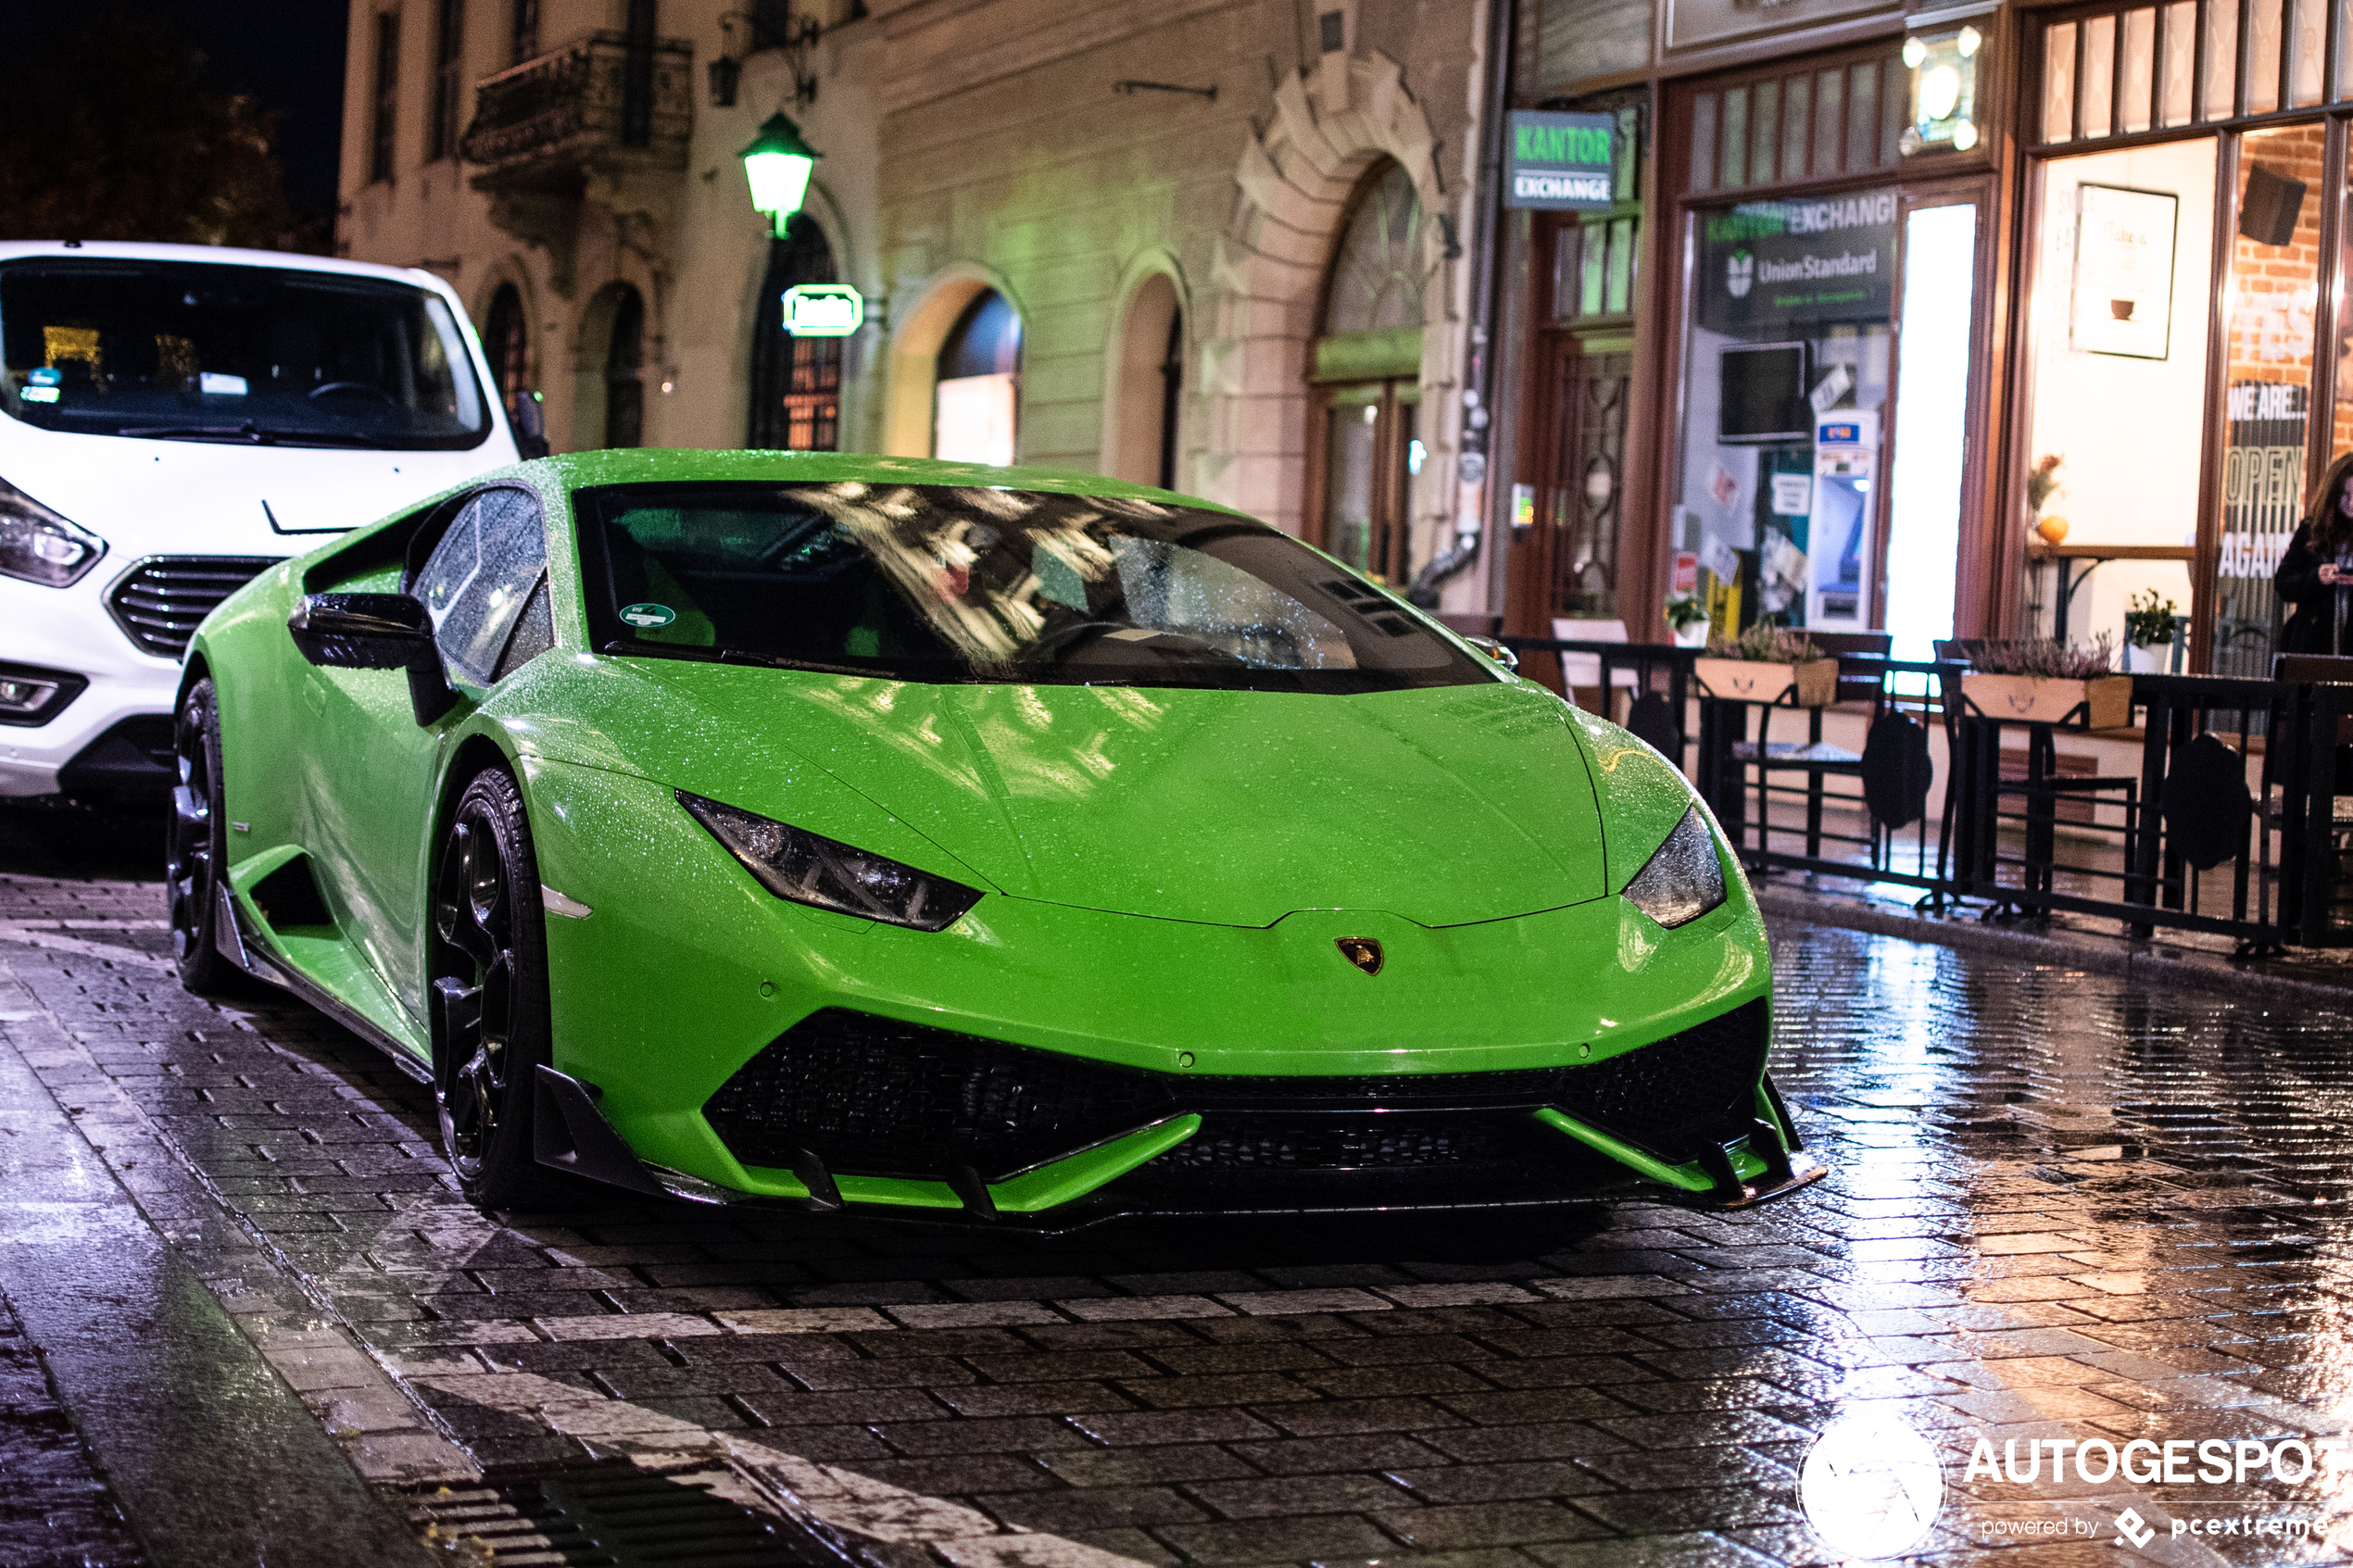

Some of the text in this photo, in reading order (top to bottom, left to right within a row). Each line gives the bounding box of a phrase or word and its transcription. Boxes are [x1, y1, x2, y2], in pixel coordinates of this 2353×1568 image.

[1516, 127, 1610, 164] KANTOR
[1516, 177, 1610, 201] EXCHANGE
[1759, 248, 1877, 283] UnionStandard
[2228, 386, 2255, 420] WE
[2225, 445, 2304, 505] OPEN
